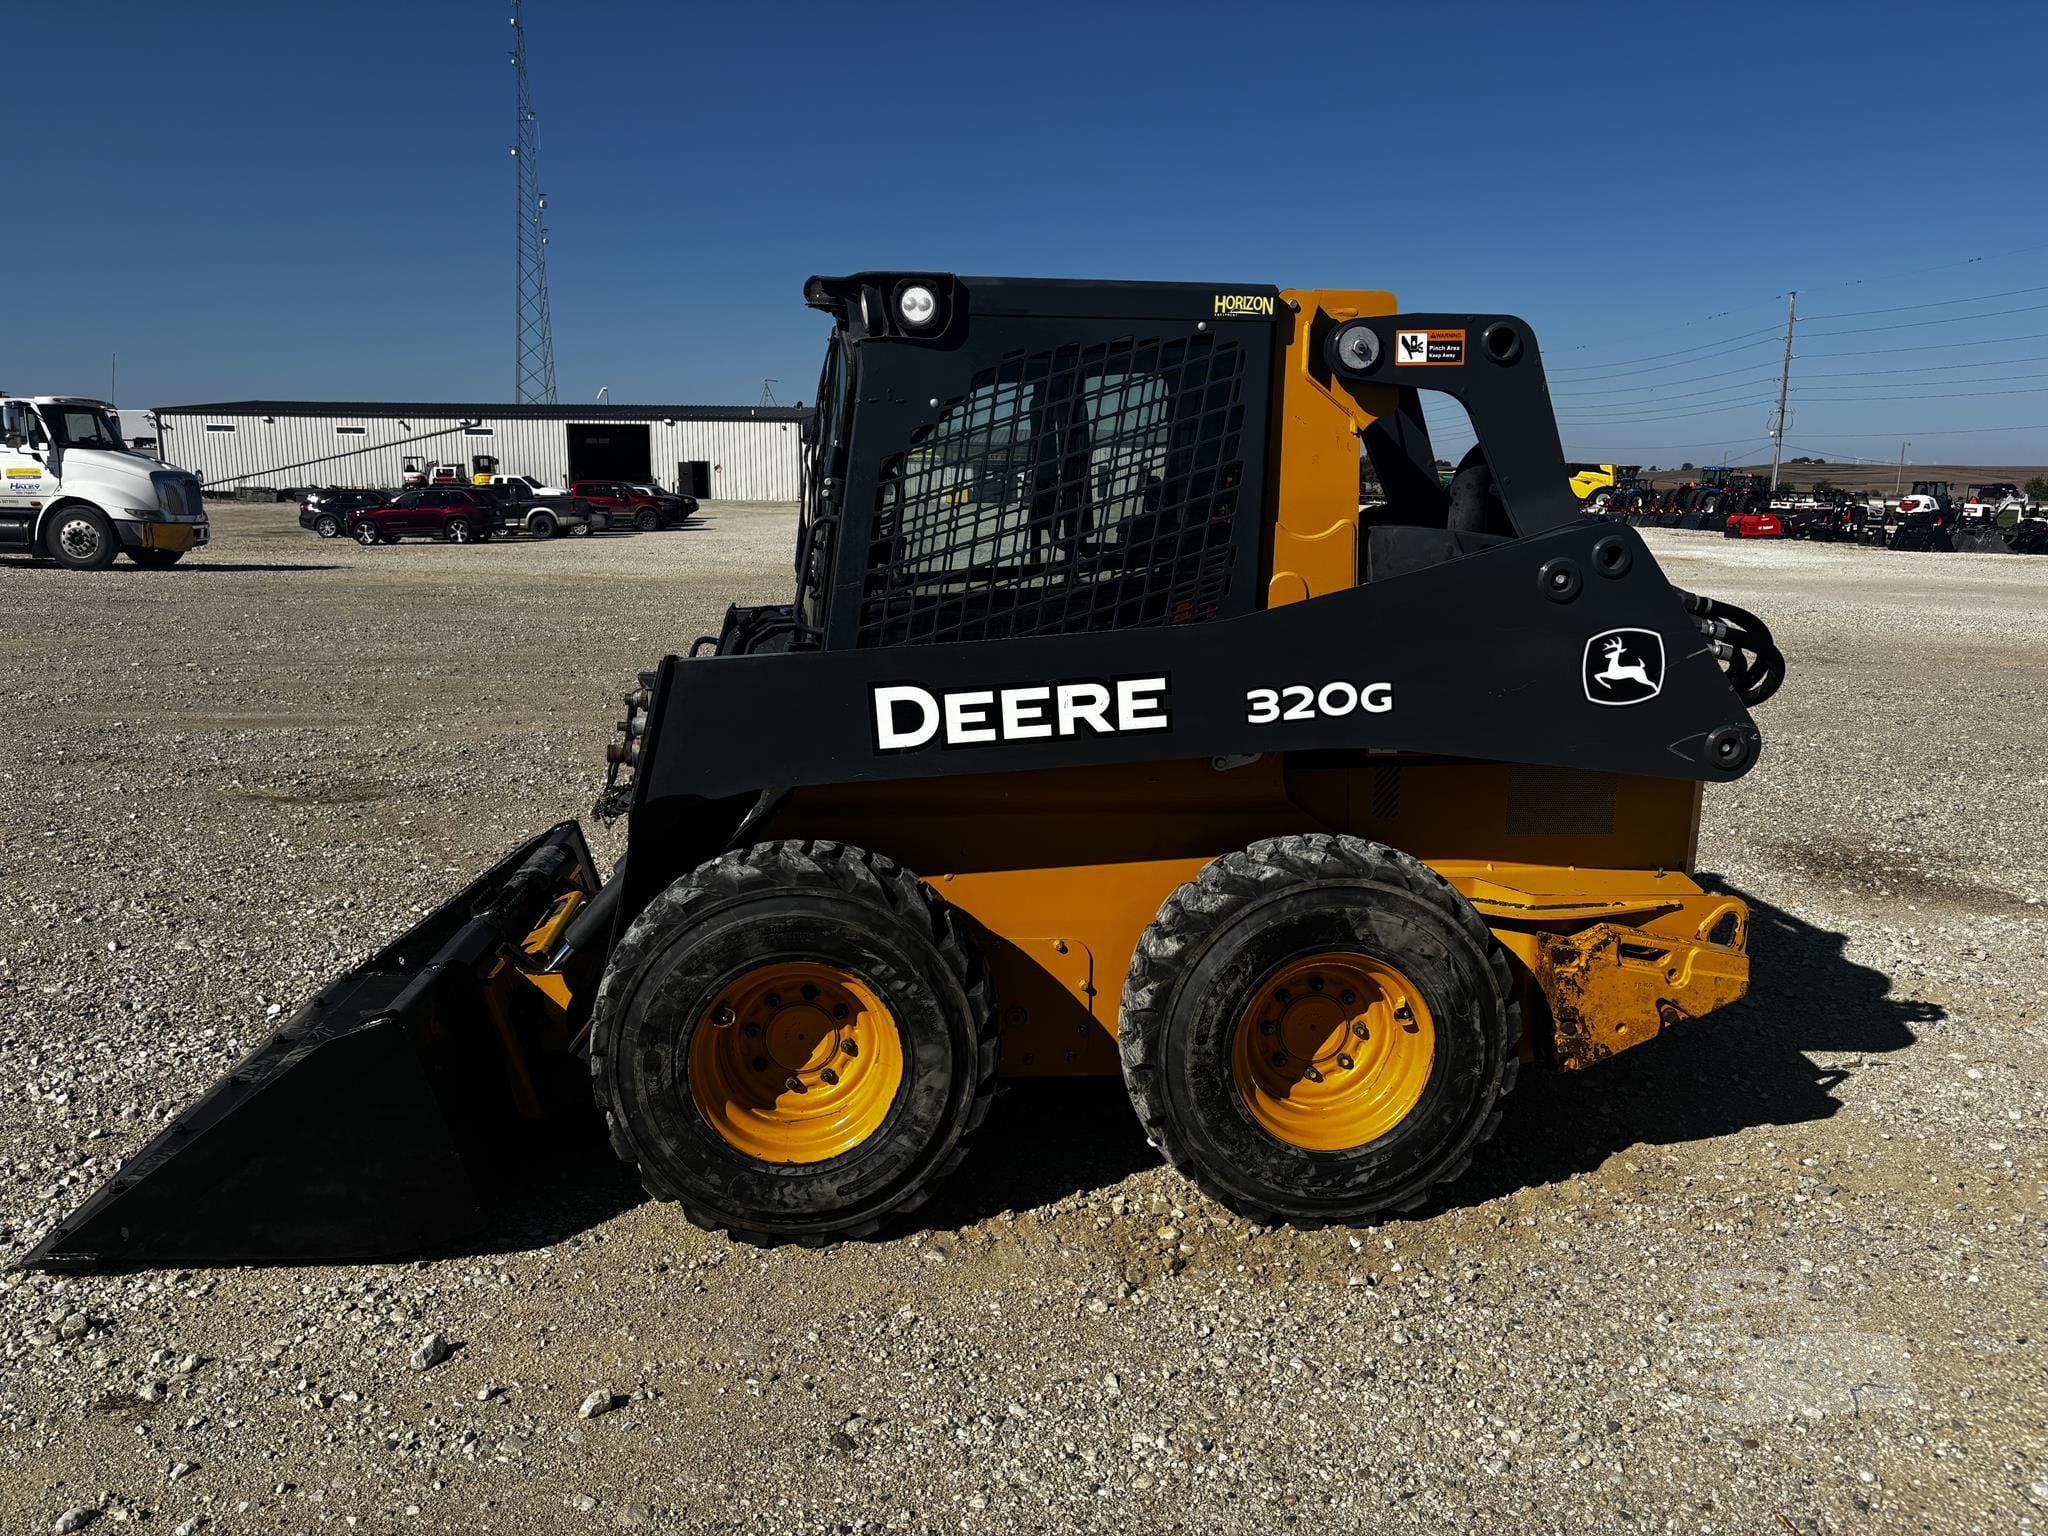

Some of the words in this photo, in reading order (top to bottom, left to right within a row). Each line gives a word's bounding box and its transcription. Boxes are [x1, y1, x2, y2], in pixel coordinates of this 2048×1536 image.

[1214, 295, 1274, 315] HORIZON
[874, 678, 1168, 750] DEERE
[1246, 682, 1393, 724] 320G
